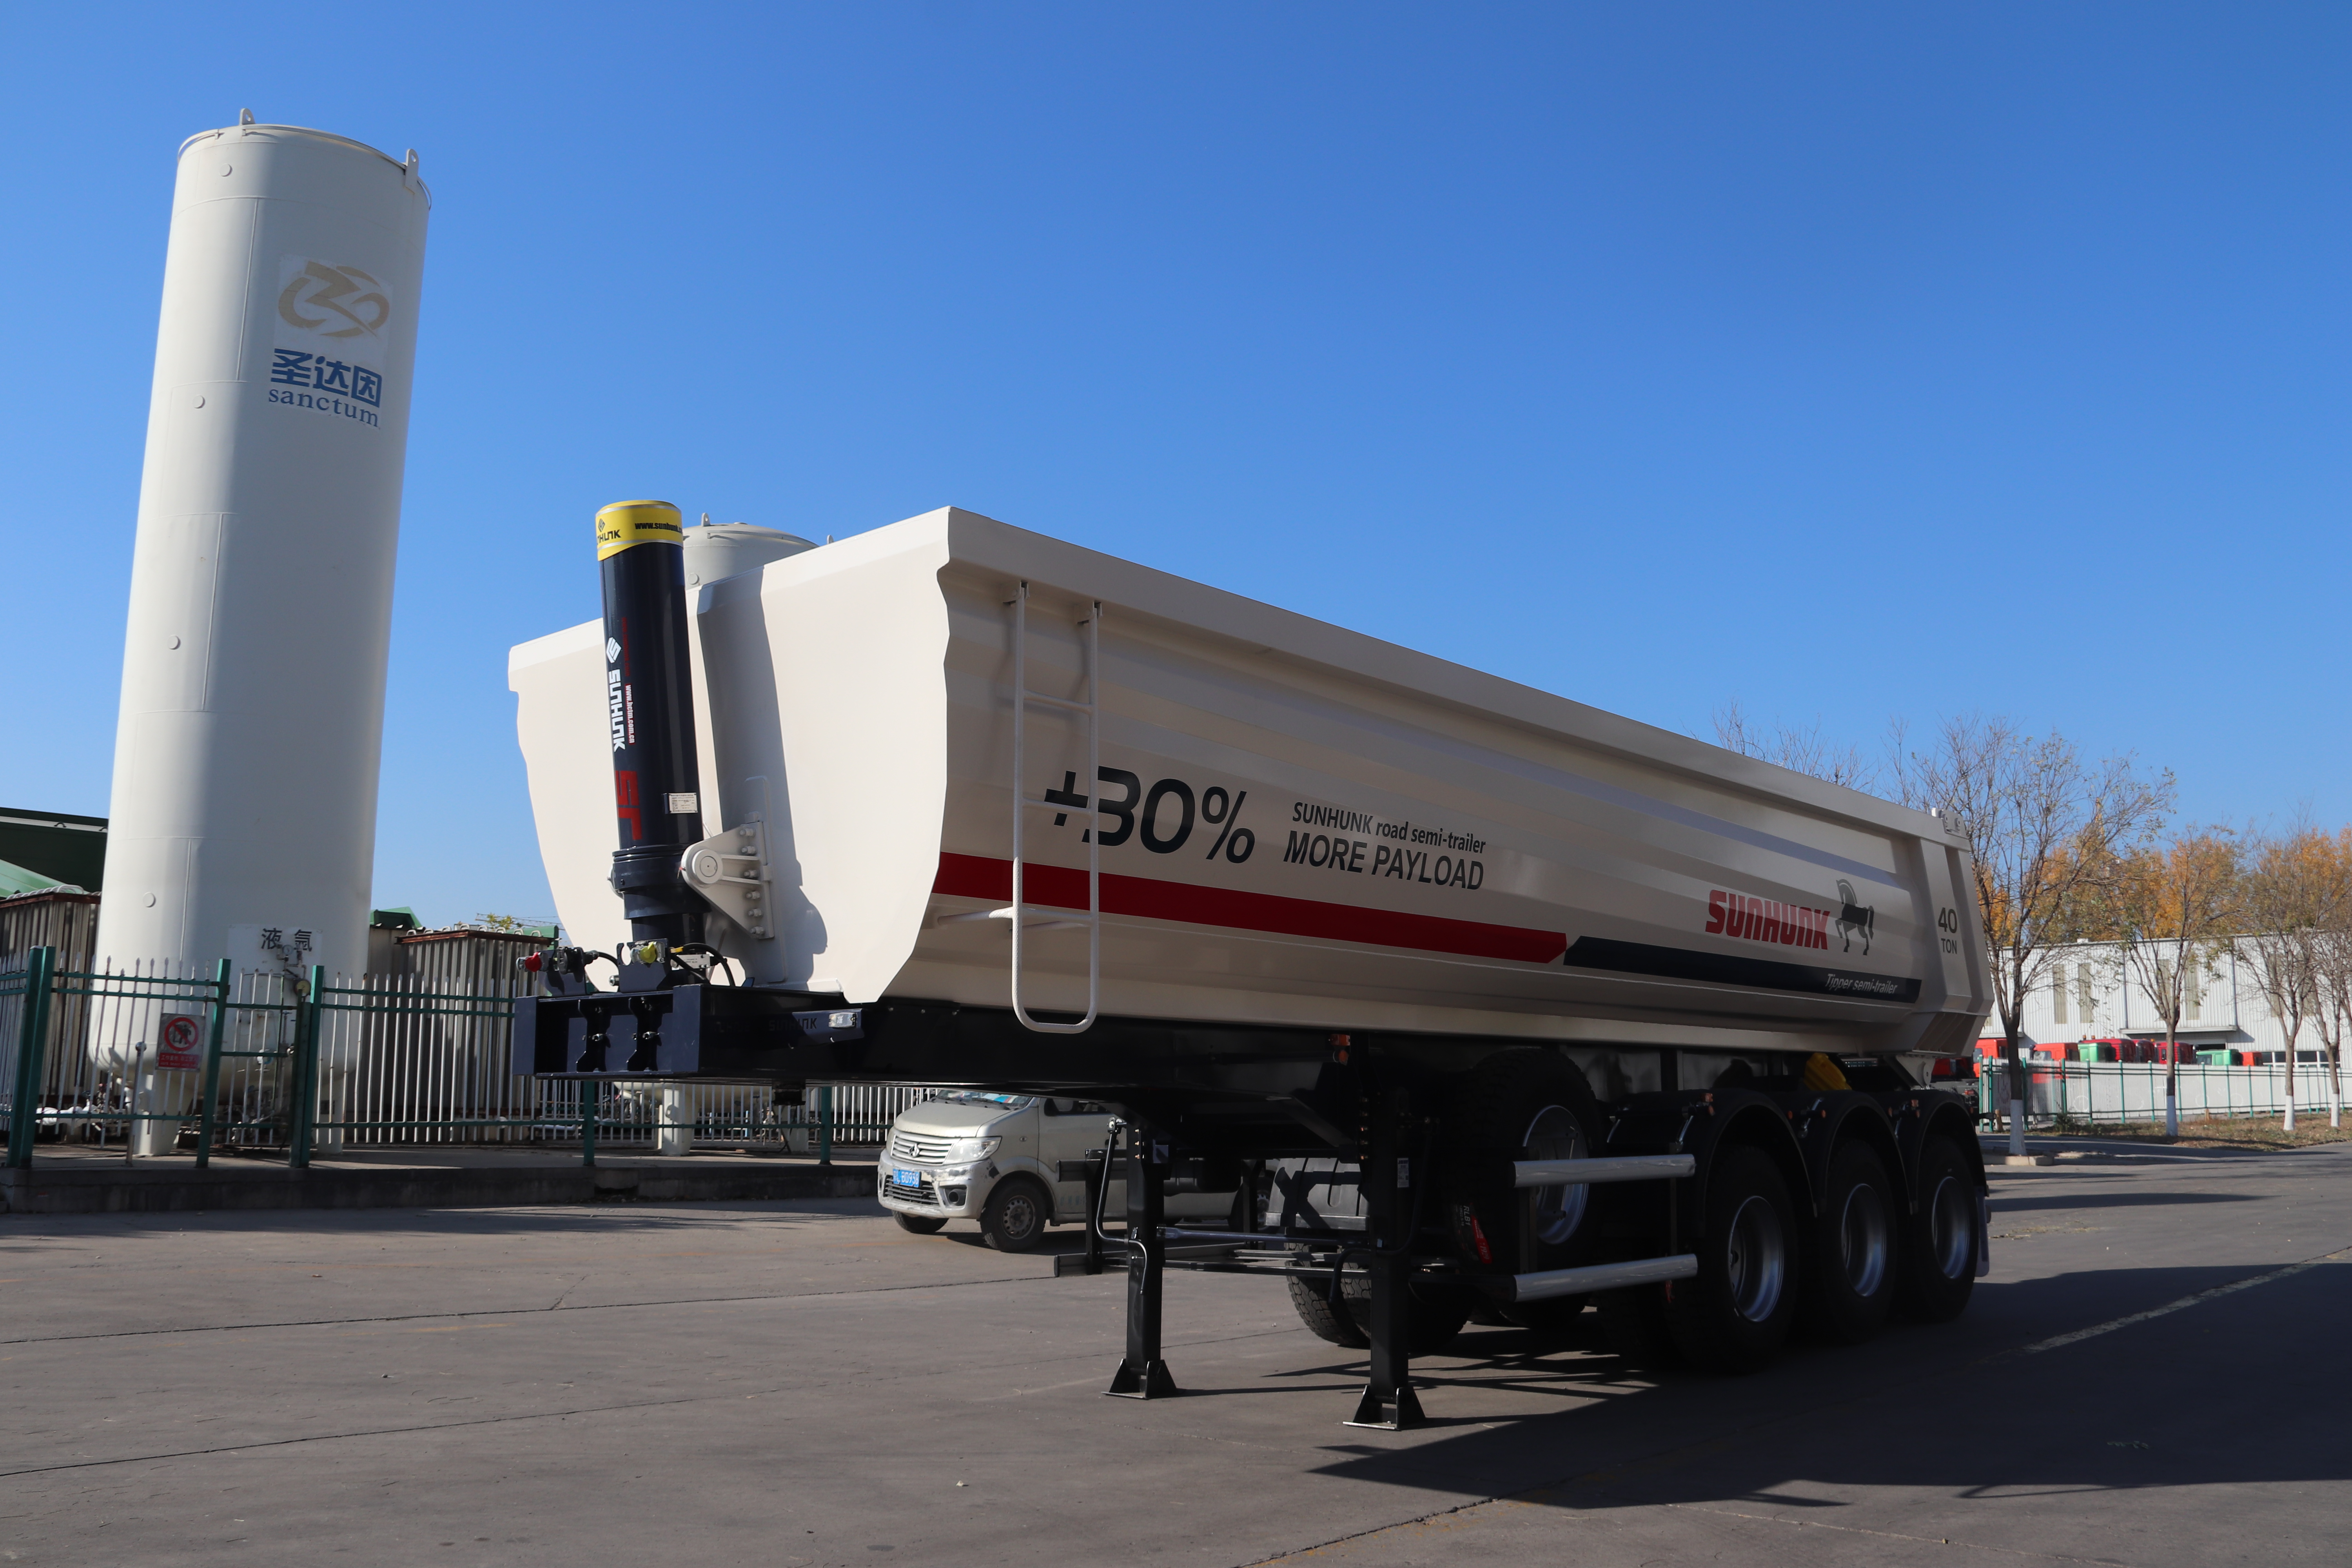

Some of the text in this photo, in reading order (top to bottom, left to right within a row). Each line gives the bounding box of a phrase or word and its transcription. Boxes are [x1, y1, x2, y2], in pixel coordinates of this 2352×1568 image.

[269, 388, 379, 427] sanctum
[271, 348, 382, 408] 圣达因
[609, 669, 626, 752] SUNHUNK
[626, 684, 635, 743] www.hctm.com.cn
[1044, 766, 1255, 863] +30%
[1292, 802, 1486, 854] SUNHUNK road semi-trailer
[1283, 830, 1484, 890] MORE PAYLOAD
[1705, 889, 1830, 950] SUNHUNK
[1938, 907, 1957, 933] 40
[1941, 938, 1957, 954] TON
[1825, 973, 1898, 994] Tipper semi-trailer
